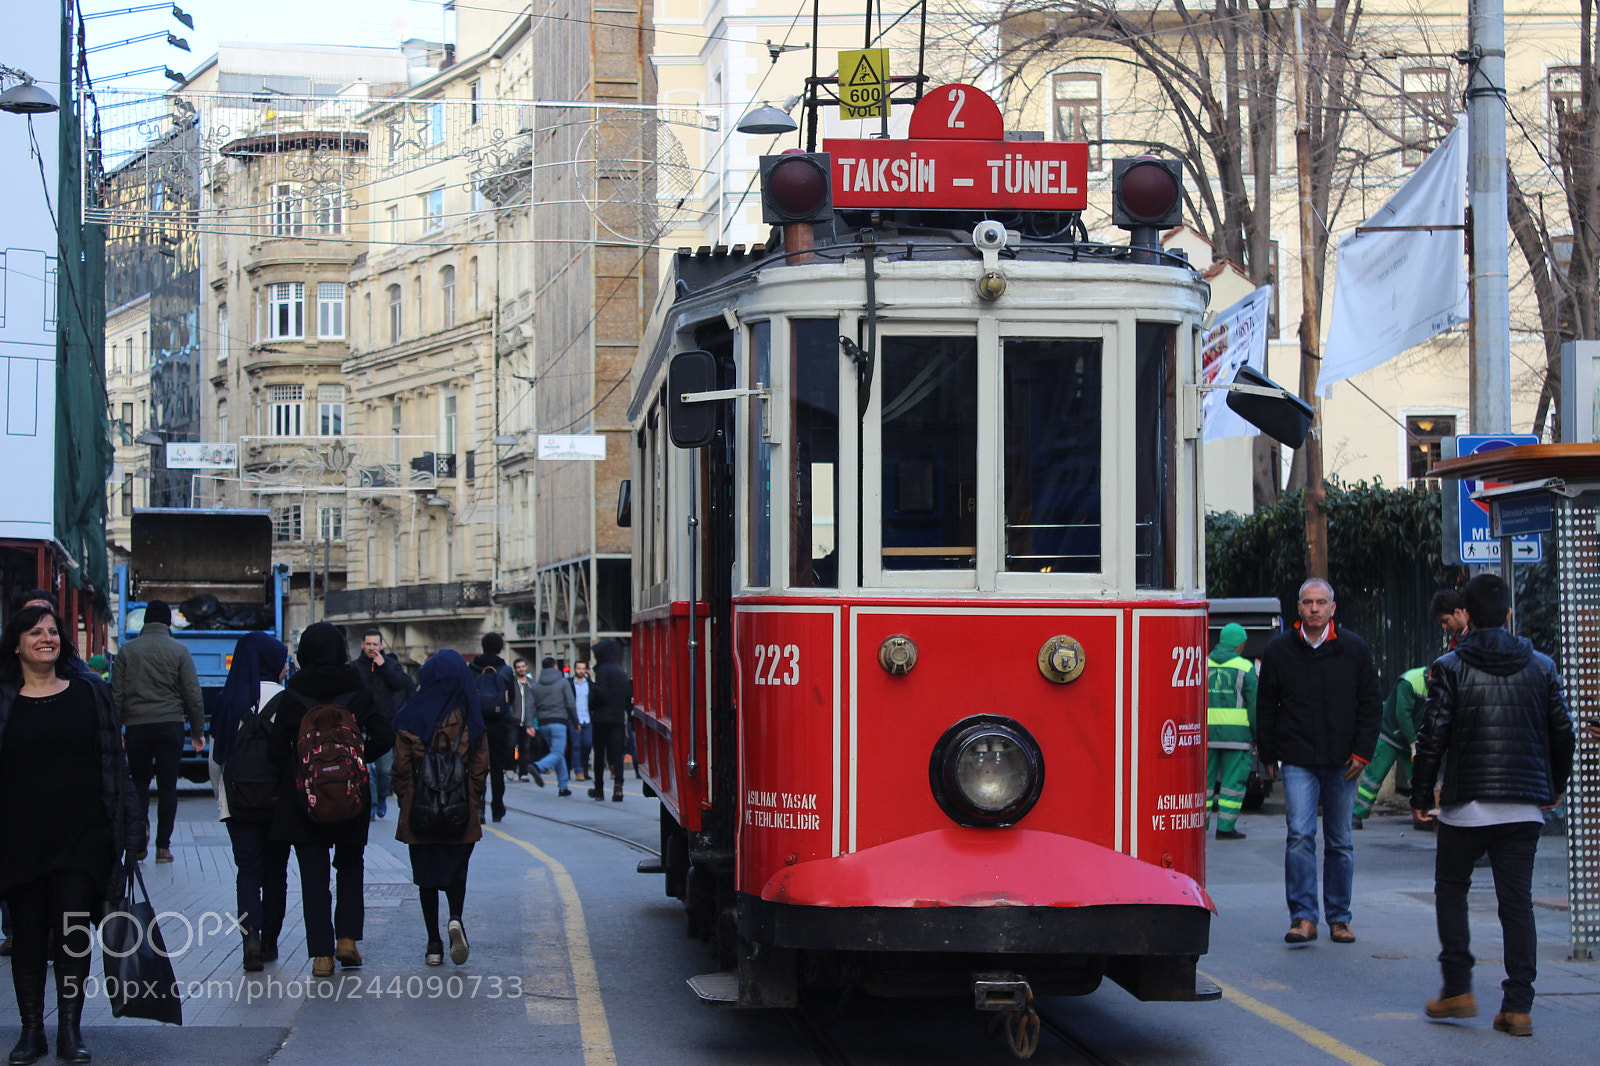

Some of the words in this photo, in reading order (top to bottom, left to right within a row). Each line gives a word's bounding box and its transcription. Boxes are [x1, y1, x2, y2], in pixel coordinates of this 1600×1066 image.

[850, 87, 880, 103] 600
[847, 105, 882, 118] VOLT
[947, 89, 966, 128] 2
[838, 152, 935, 192] TAKSİM
[986, 154, 1078, 194] TÜNEL
[754, 644, 800, 686] 223
[1171, 646, 1202, 687] 223
[1178, 735, 1193, 747] ALO
[781, 793, 817, 810] YASAK
[745, 809, 752, 825] VE
[754, 810, 820, 830] TEHLİKELİDİR
[1152, 815, 1166, 831] VE
